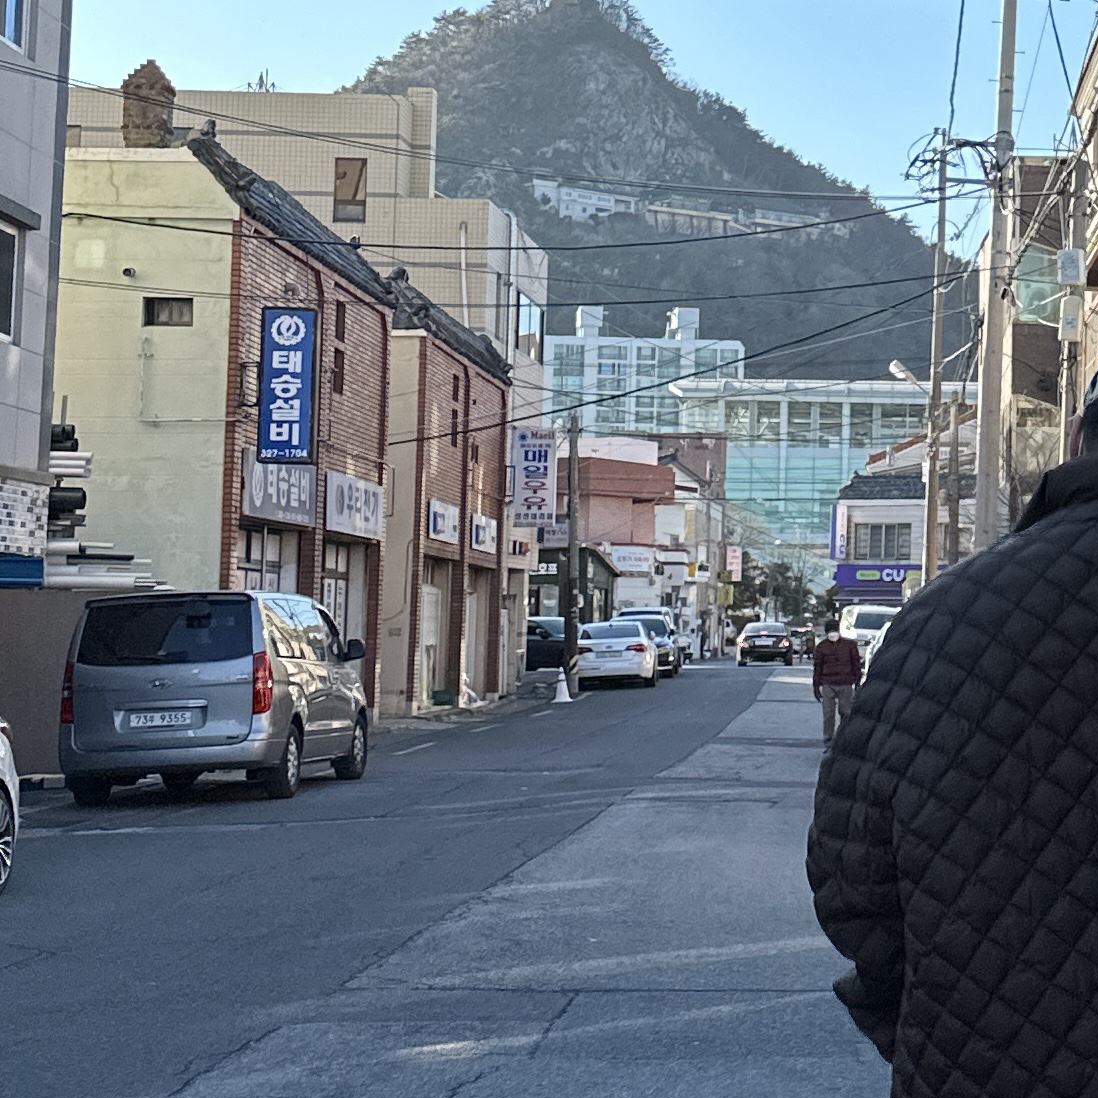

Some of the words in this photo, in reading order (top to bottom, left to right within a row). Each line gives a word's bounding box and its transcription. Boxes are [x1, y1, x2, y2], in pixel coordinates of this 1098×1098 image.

[269, 350, 303, 446] 태승설비
[260, 448, 308, 458] 327-1704
[521, 449, 549, 511] 매일우유
[881, 568, 905, 582] CU
[160, 712, 187, 724] 9355
